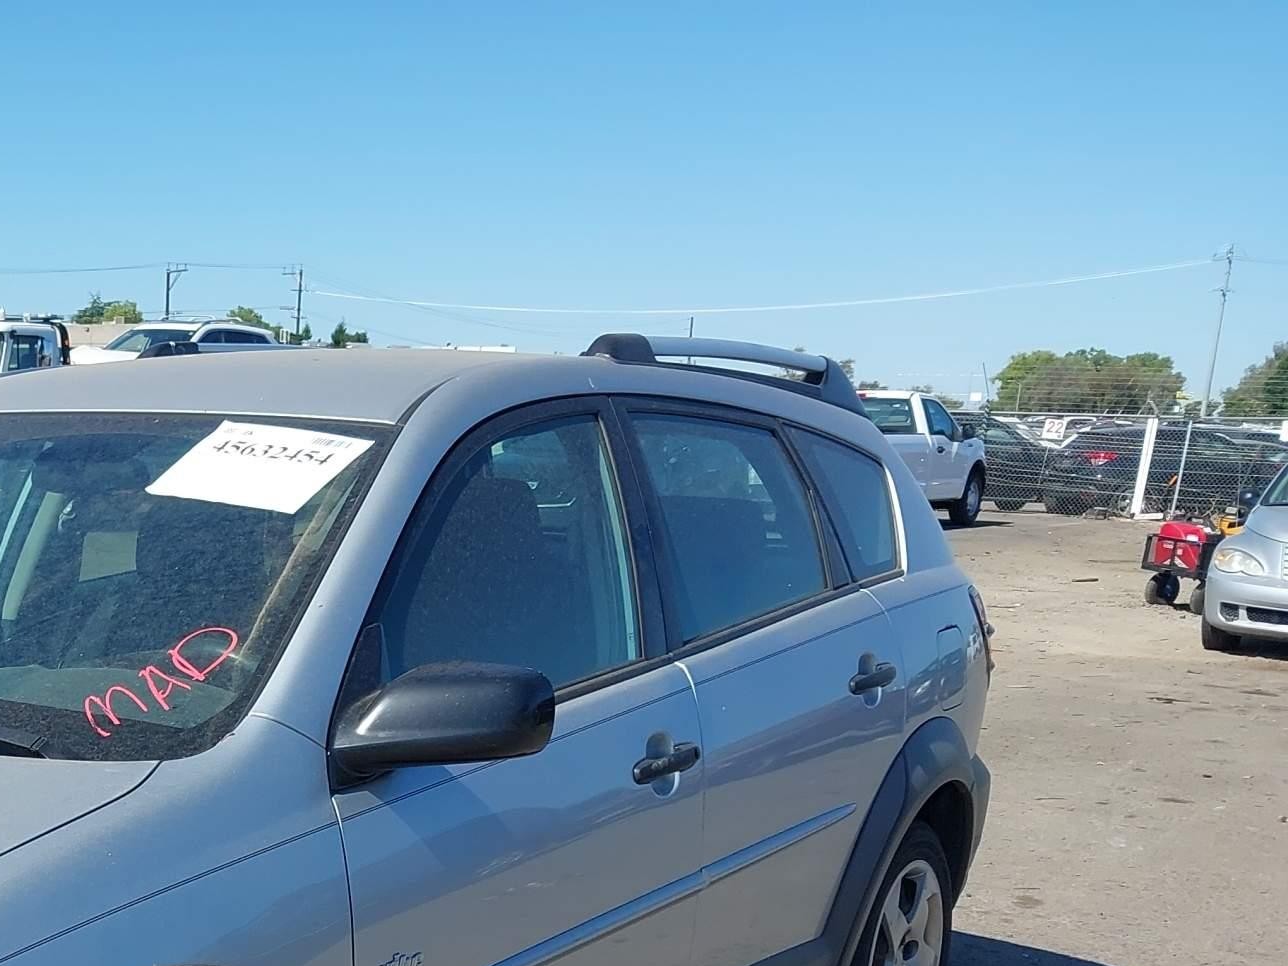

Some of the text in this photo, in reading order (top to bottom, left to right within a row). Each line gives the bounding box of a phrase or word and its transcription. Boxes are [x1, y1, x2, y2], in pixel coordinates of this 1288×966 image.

[1046, 421, 1063, 433] 22
[213, 440, 335, 465] 45632454
[84, 627, 238, 737] MAD
